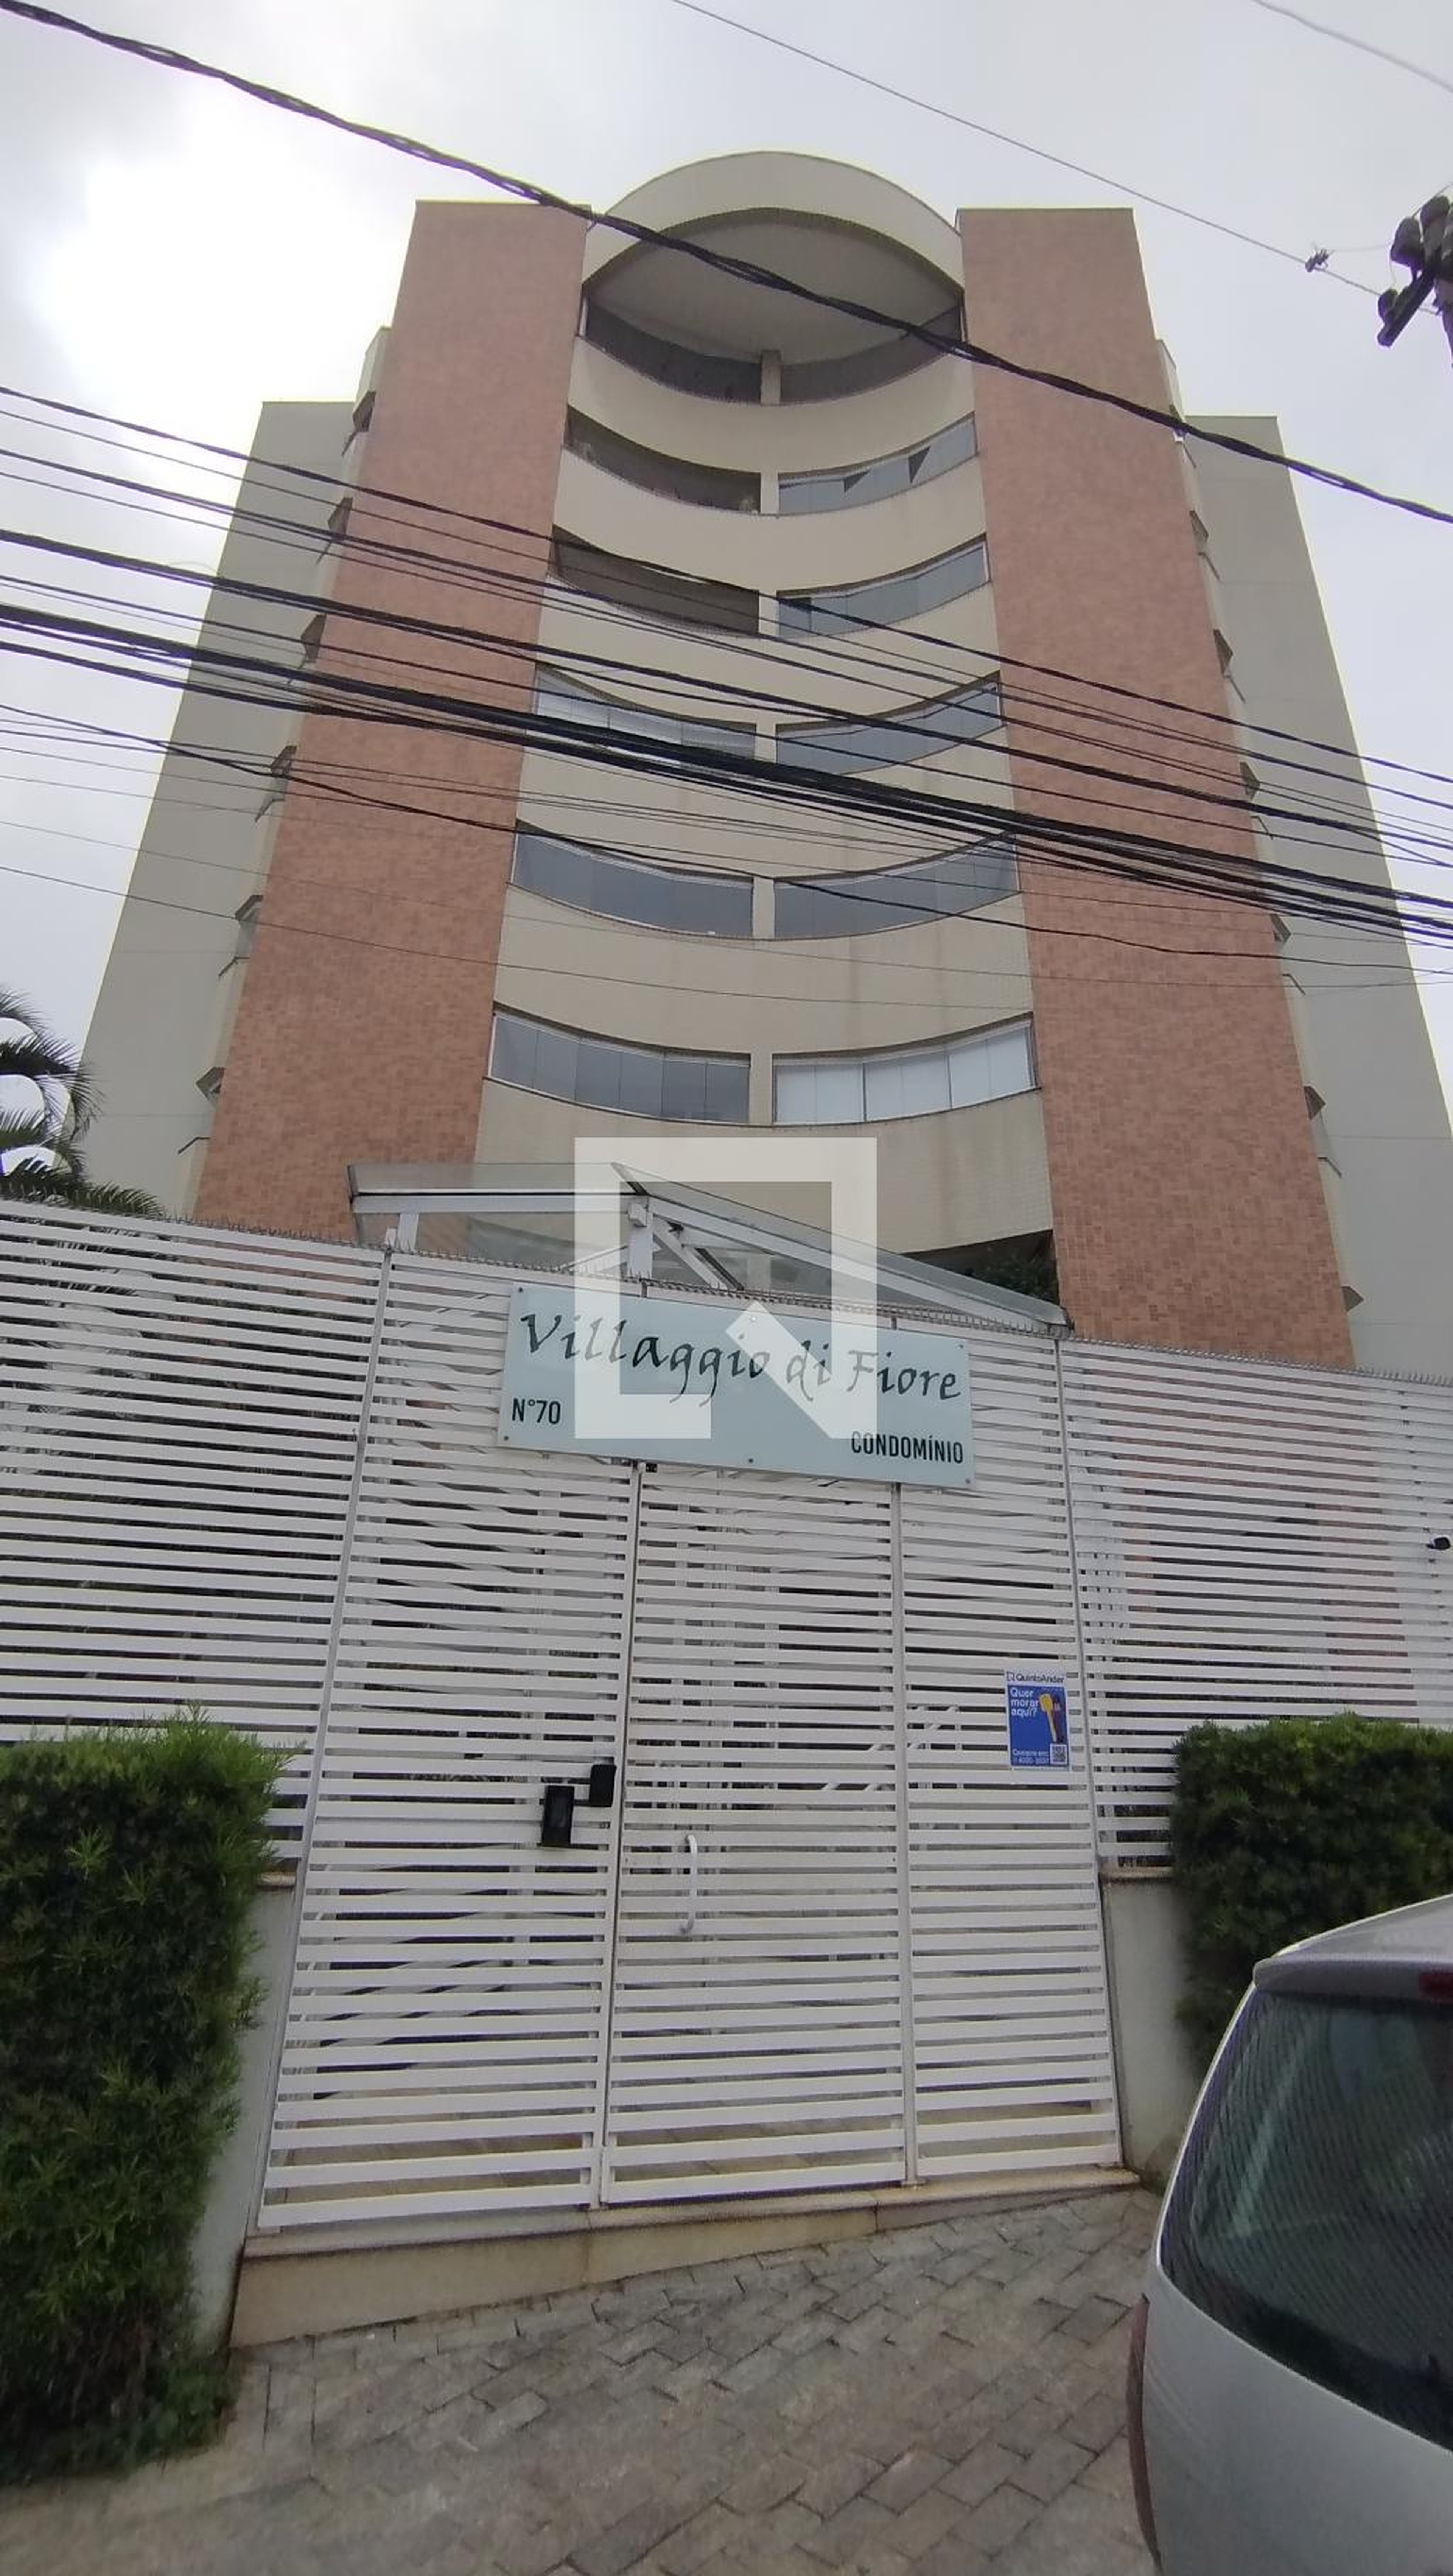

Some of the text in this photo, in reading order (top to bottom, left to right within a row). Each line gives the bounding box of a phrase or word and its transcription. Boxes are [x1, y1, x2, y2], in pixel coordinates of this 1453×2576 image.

[521, 1314, 961, 1407] Villaggio di Fiore
[851, 1431, 963, 1463] CONDOMÍNIO
[1010, 1687, 1034, 1697] Quer
